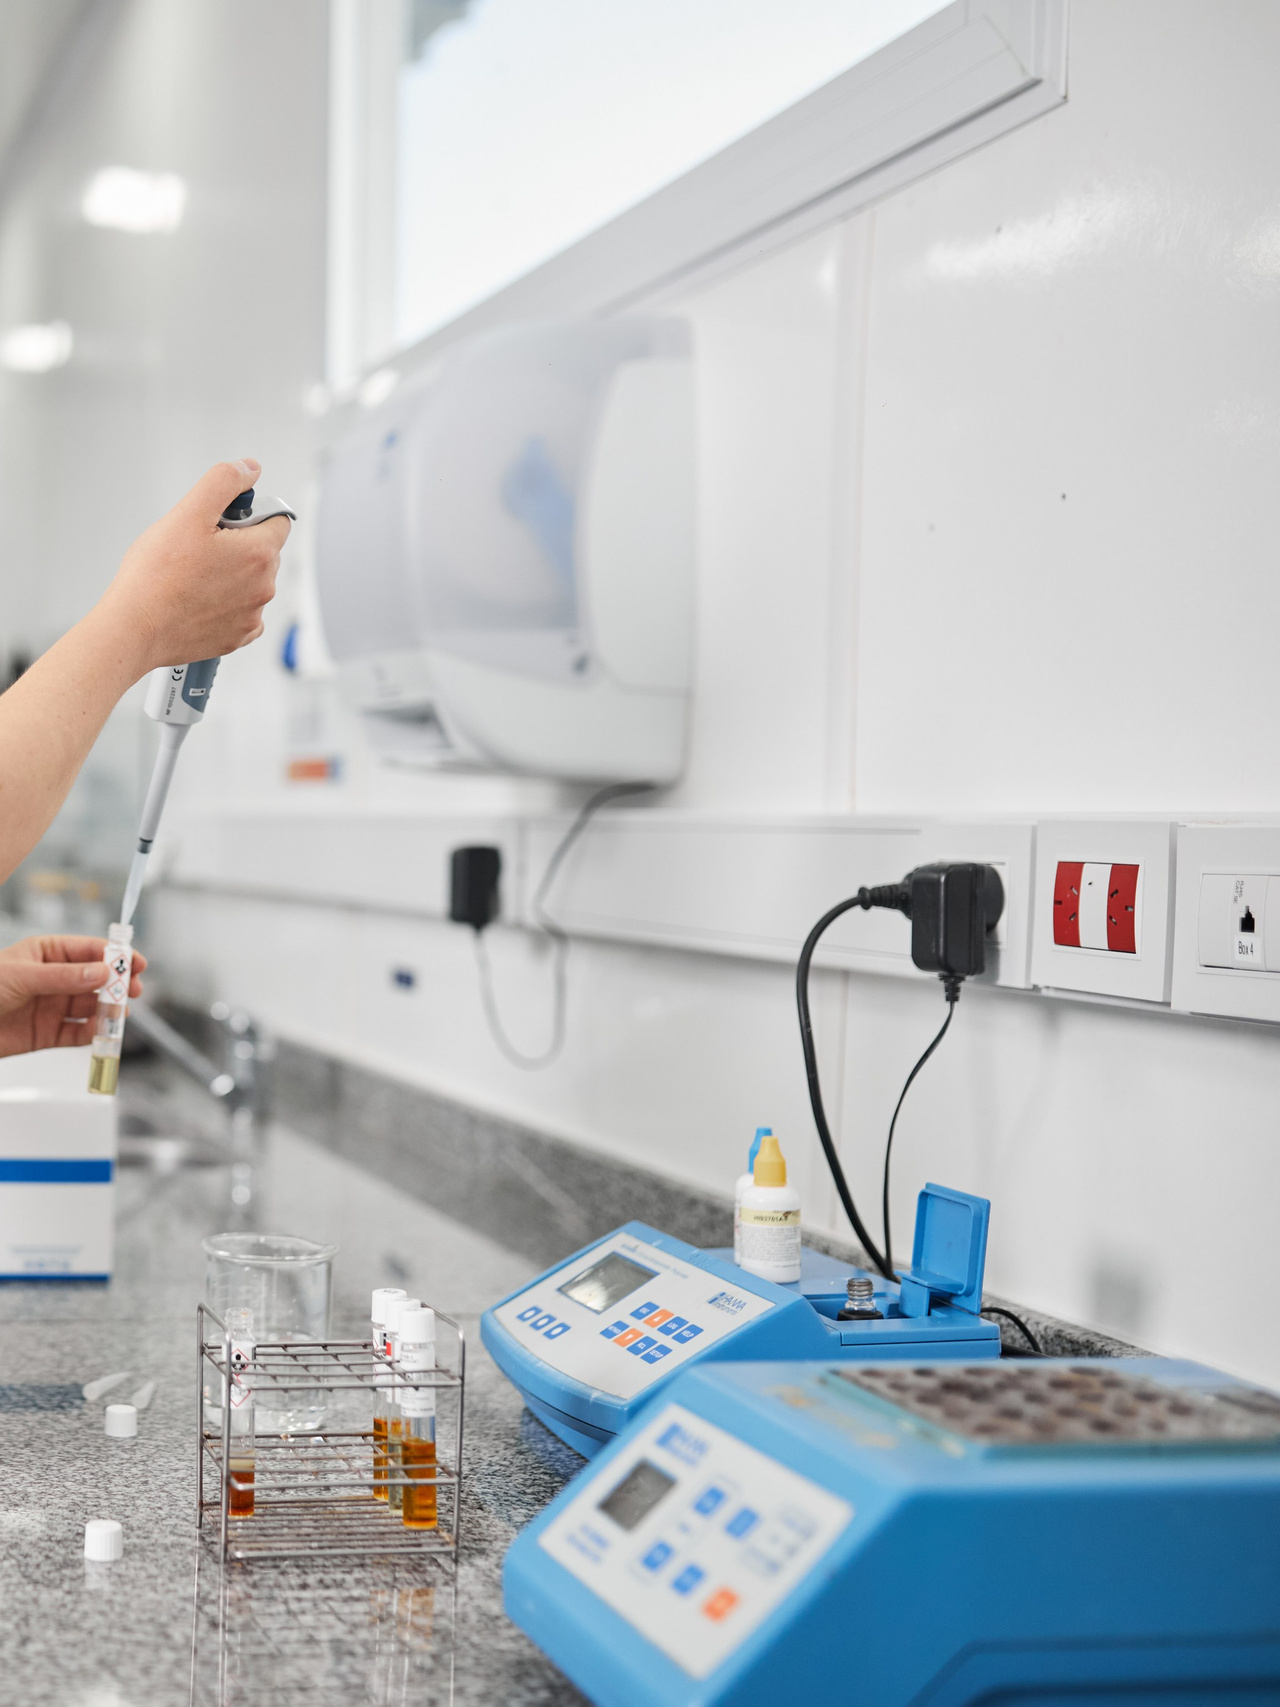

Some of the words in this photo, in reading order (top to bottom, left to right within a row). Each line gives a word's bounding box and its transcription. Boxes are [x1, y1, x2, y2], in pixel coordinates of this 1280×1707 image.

[1238, 941, 1249, 955] Box
[1250, 942, 1254, 956] 4
[681, 1330, 695, 1338] HELP
[649, 1349, 664, 1358] SETUP
